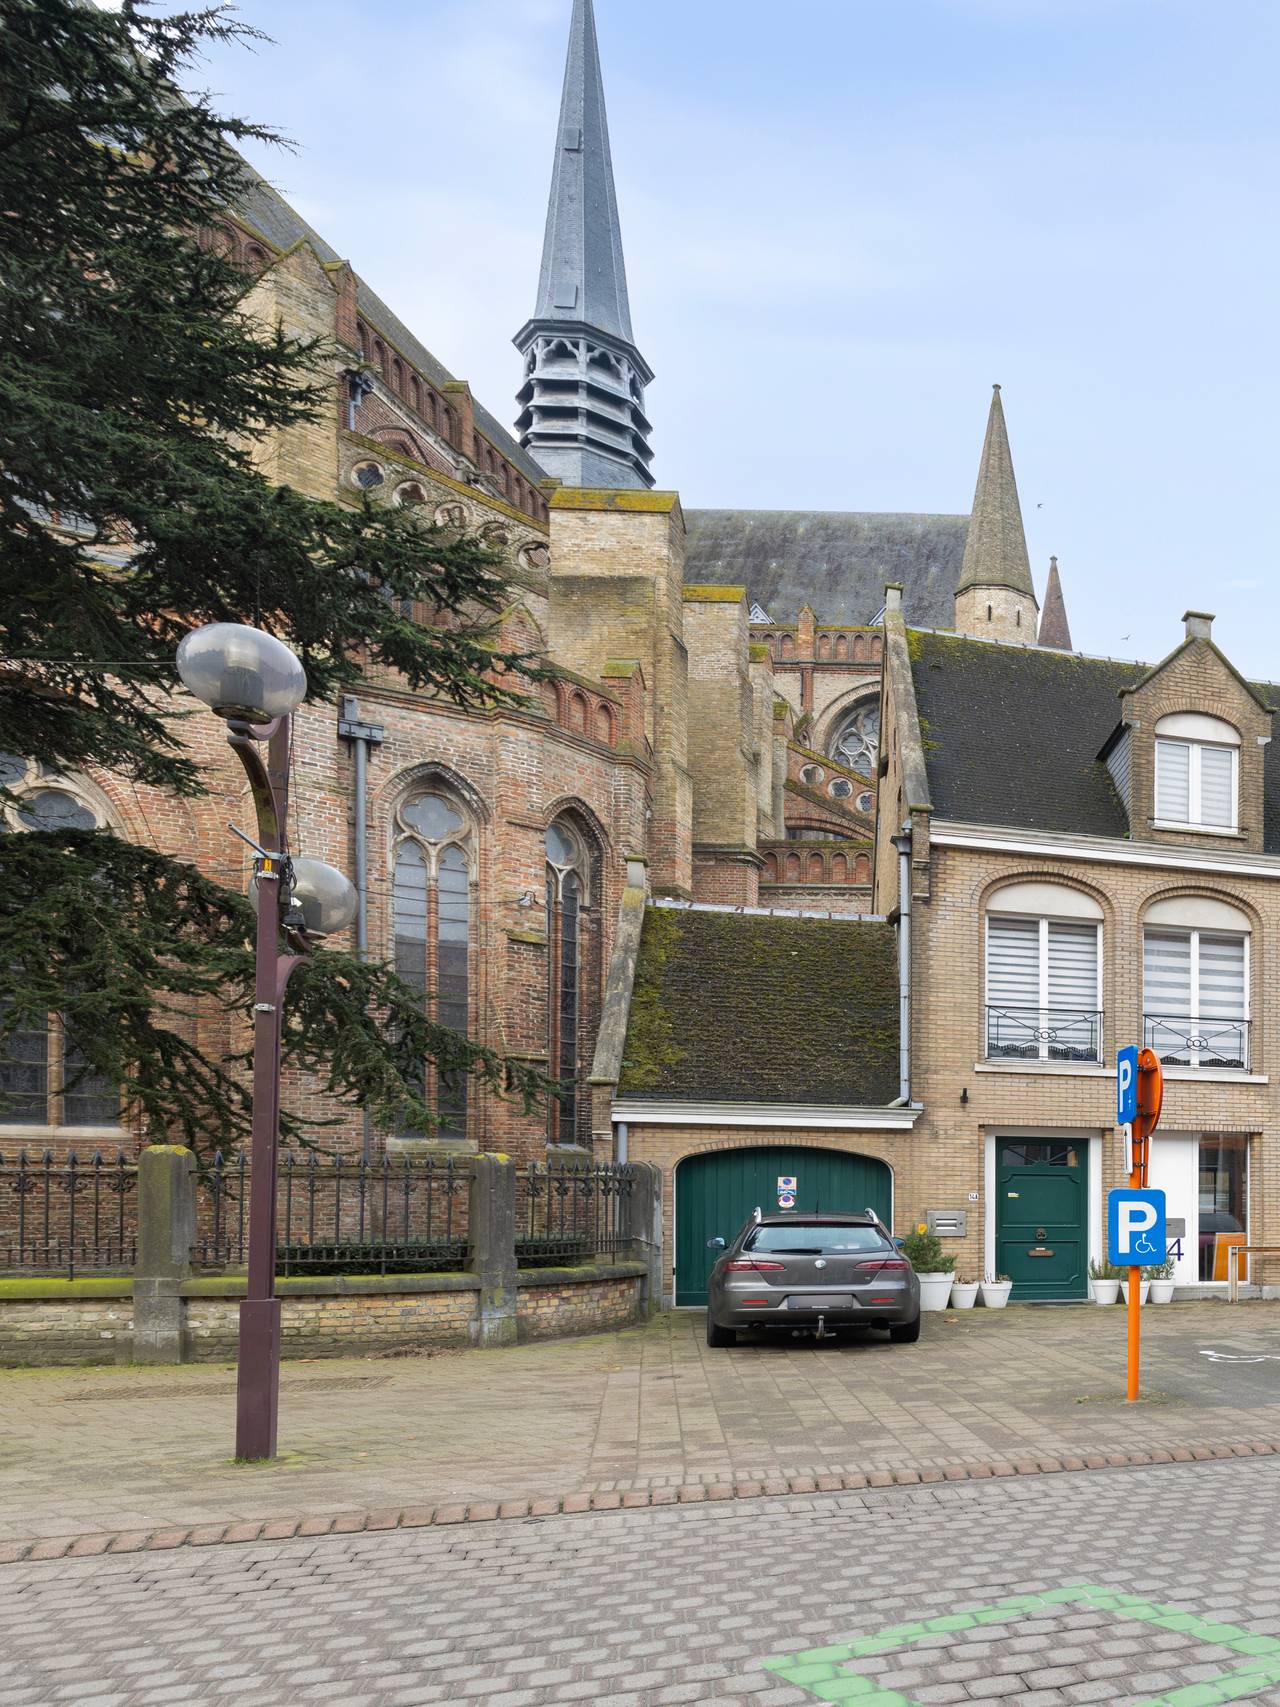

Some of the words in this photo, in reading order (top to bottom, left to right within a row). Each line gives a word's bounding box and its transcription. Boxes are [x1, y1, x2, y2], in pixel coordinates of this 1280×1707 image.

[1119, 1060, 1132, 1112] P
[1118, 1201, 1157, 1254] P
[1167, 1238, 1184, 1261] 4
